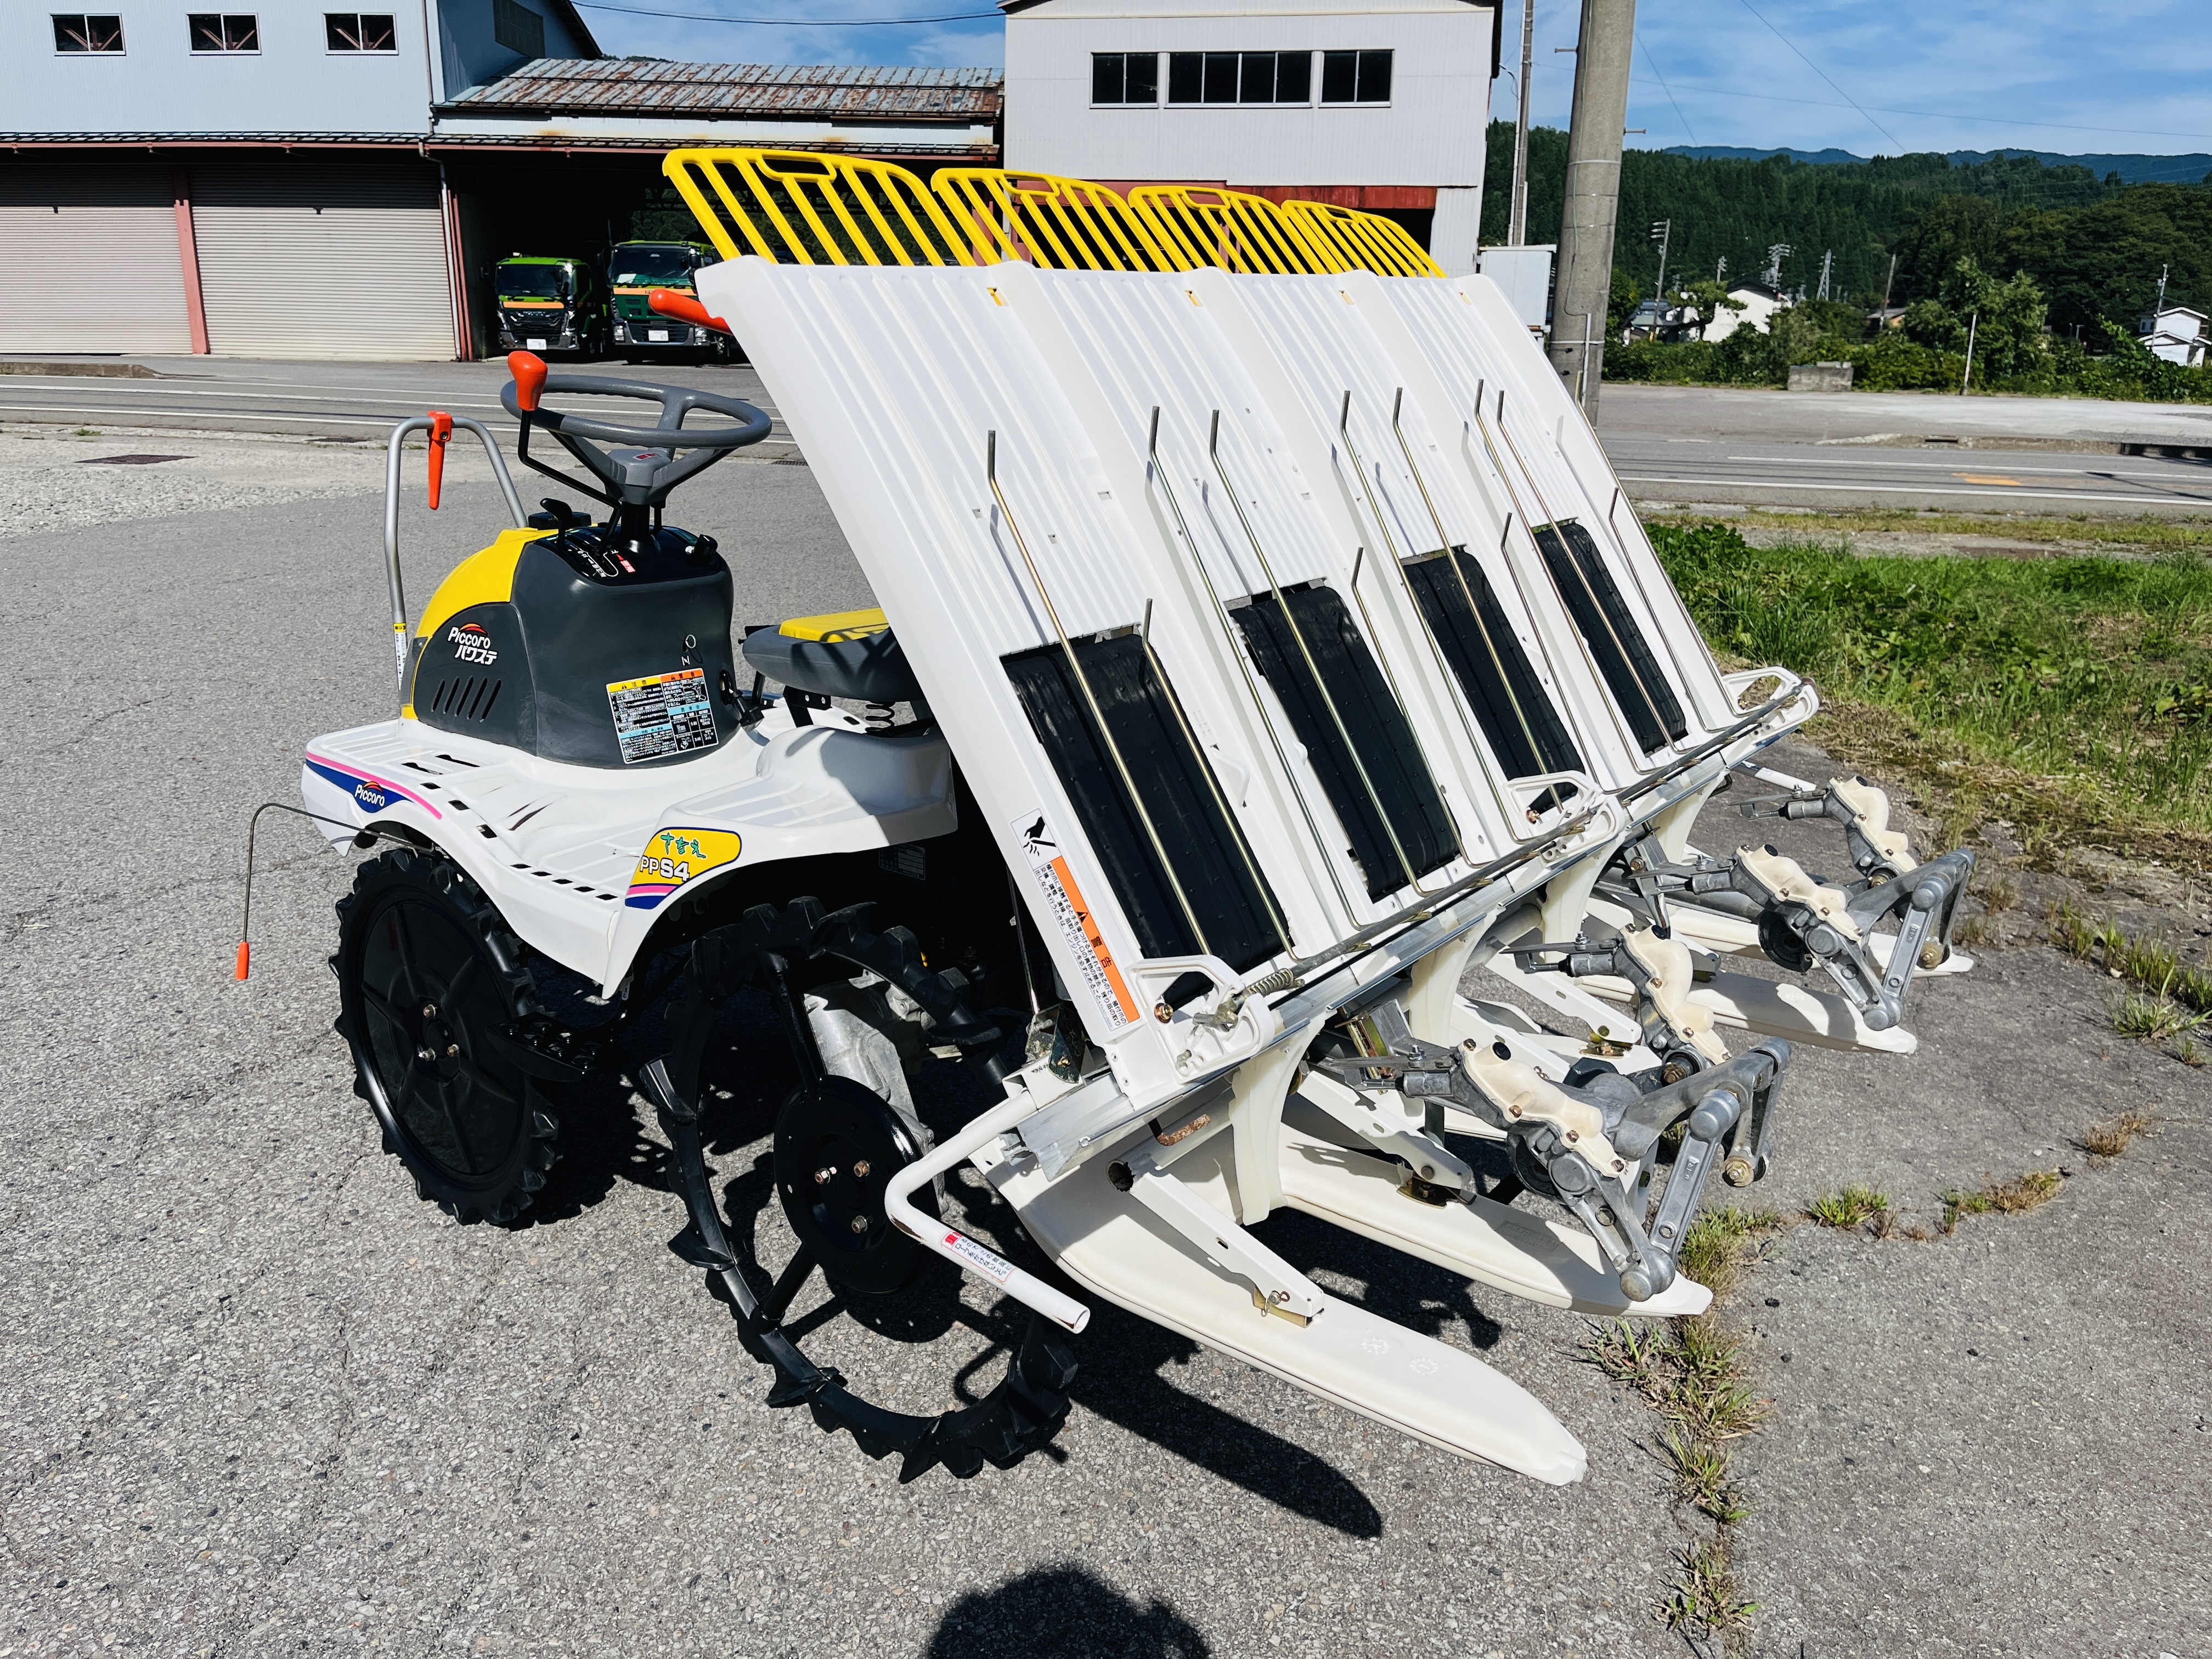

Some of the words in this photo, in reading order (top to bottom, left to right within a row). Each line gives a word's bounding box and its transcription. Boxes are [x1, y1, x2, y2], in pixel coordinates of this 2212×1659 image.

[448, 627, 491, 649] Piccoro
[454, 645, 498, 665] パワステ
[681, 655, 691, 666] N
[354, 784, 385, 807] Piccoro
[640, 855, 691, 882] PPS4
[1090, 935, 1113, 969] 警告
